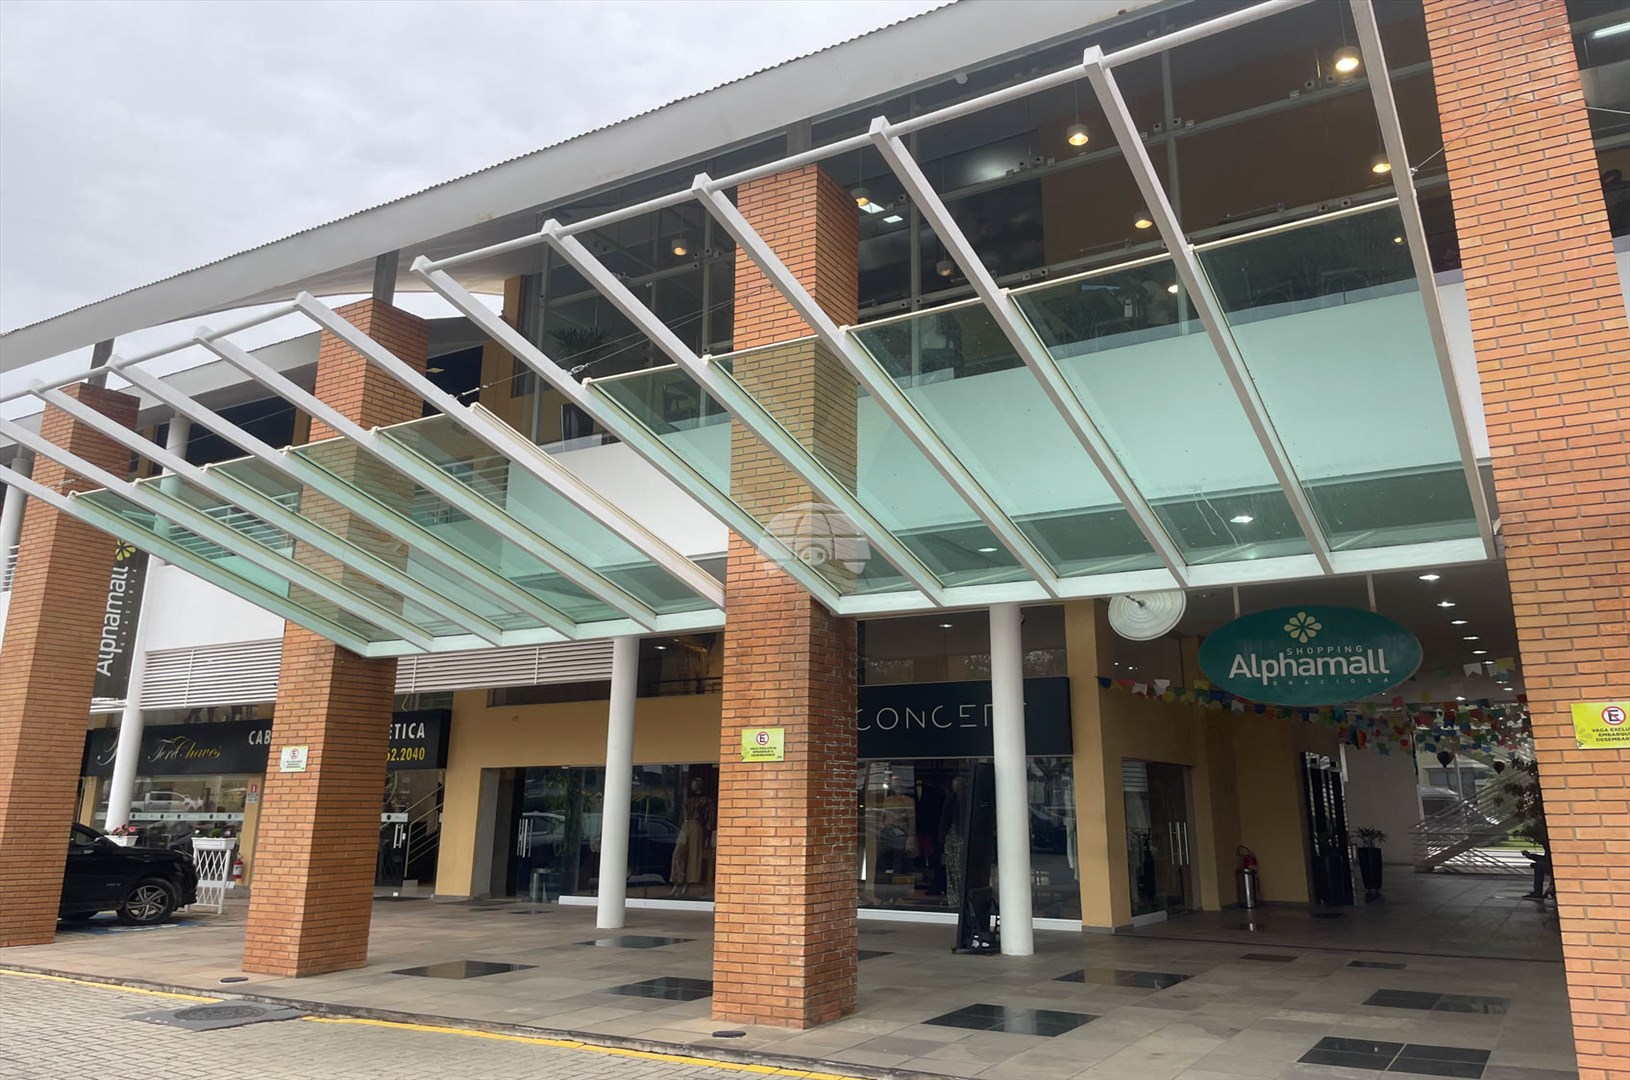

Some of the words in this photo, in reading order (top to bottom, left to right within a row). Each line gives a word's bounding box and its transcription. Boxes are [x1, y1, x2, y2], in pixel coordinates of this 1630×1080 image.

[1286, 644, 1363, 656] SHOPPING
[1228, 648, 1390, 686] Alphamall
[856, 702, 1027, 732] CONCE
